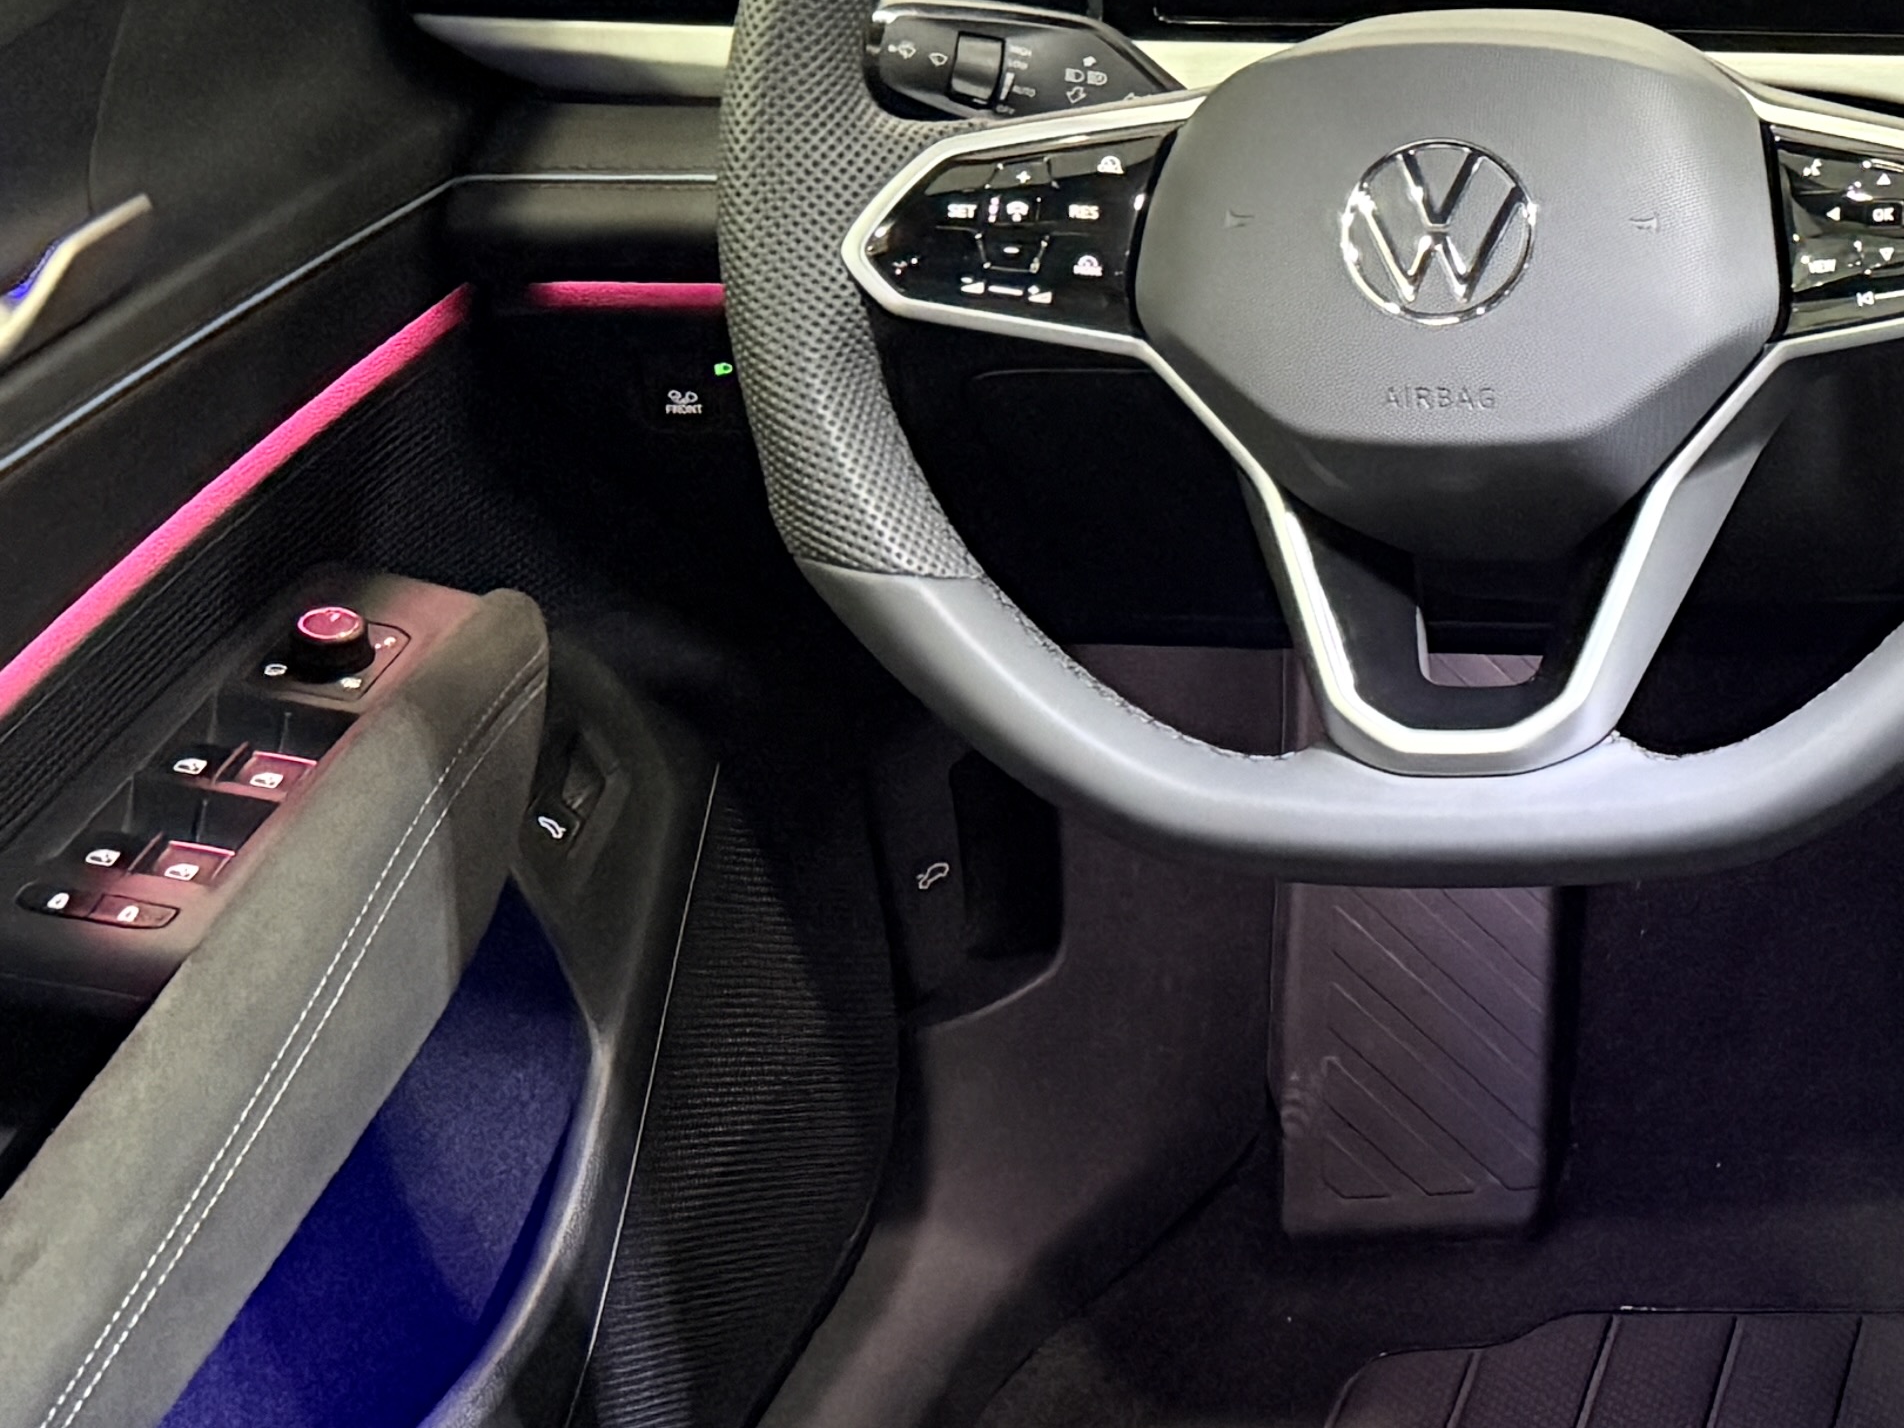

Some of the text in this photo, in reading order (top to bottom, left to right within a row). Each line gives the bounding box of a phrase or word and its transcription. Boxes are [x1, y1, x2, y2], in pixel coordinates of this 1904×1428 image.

[947, 204, 977, 219] SET
[1068, 204, 1100, 220] RES
[1872, 207, 1895, 222] OK
[1386, 386, 1496, 410] AIRBAG
[665, 403, 703, 414] FRONT
